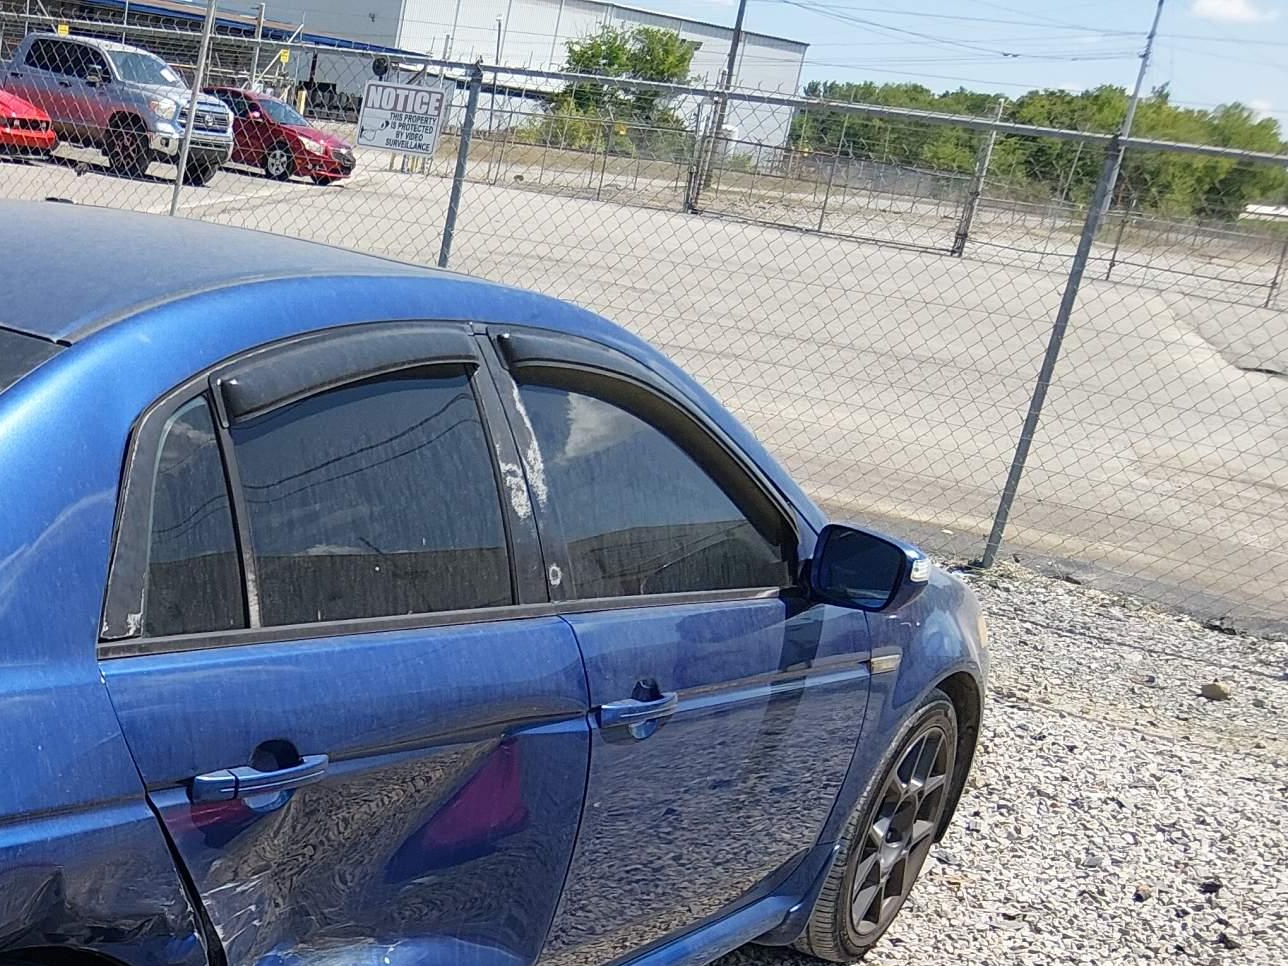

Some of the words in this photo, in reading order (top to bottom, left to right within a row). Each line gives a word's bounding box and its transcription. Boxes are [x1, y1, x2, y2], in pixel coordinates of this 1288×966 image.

[367, 85, 442, 116] NOTICE
[390, 112, 404, 121] THIS
[404, 114, 437, 126] PROPERTY
[390, 122, 397, 130] IS
[397, 122, 434, 134] PROTECTED
[395, 130, 404, 139] BY
[405, 131, 424, 142] VIDEO
[385, 138, 431, 152] SURVEILLANCE
